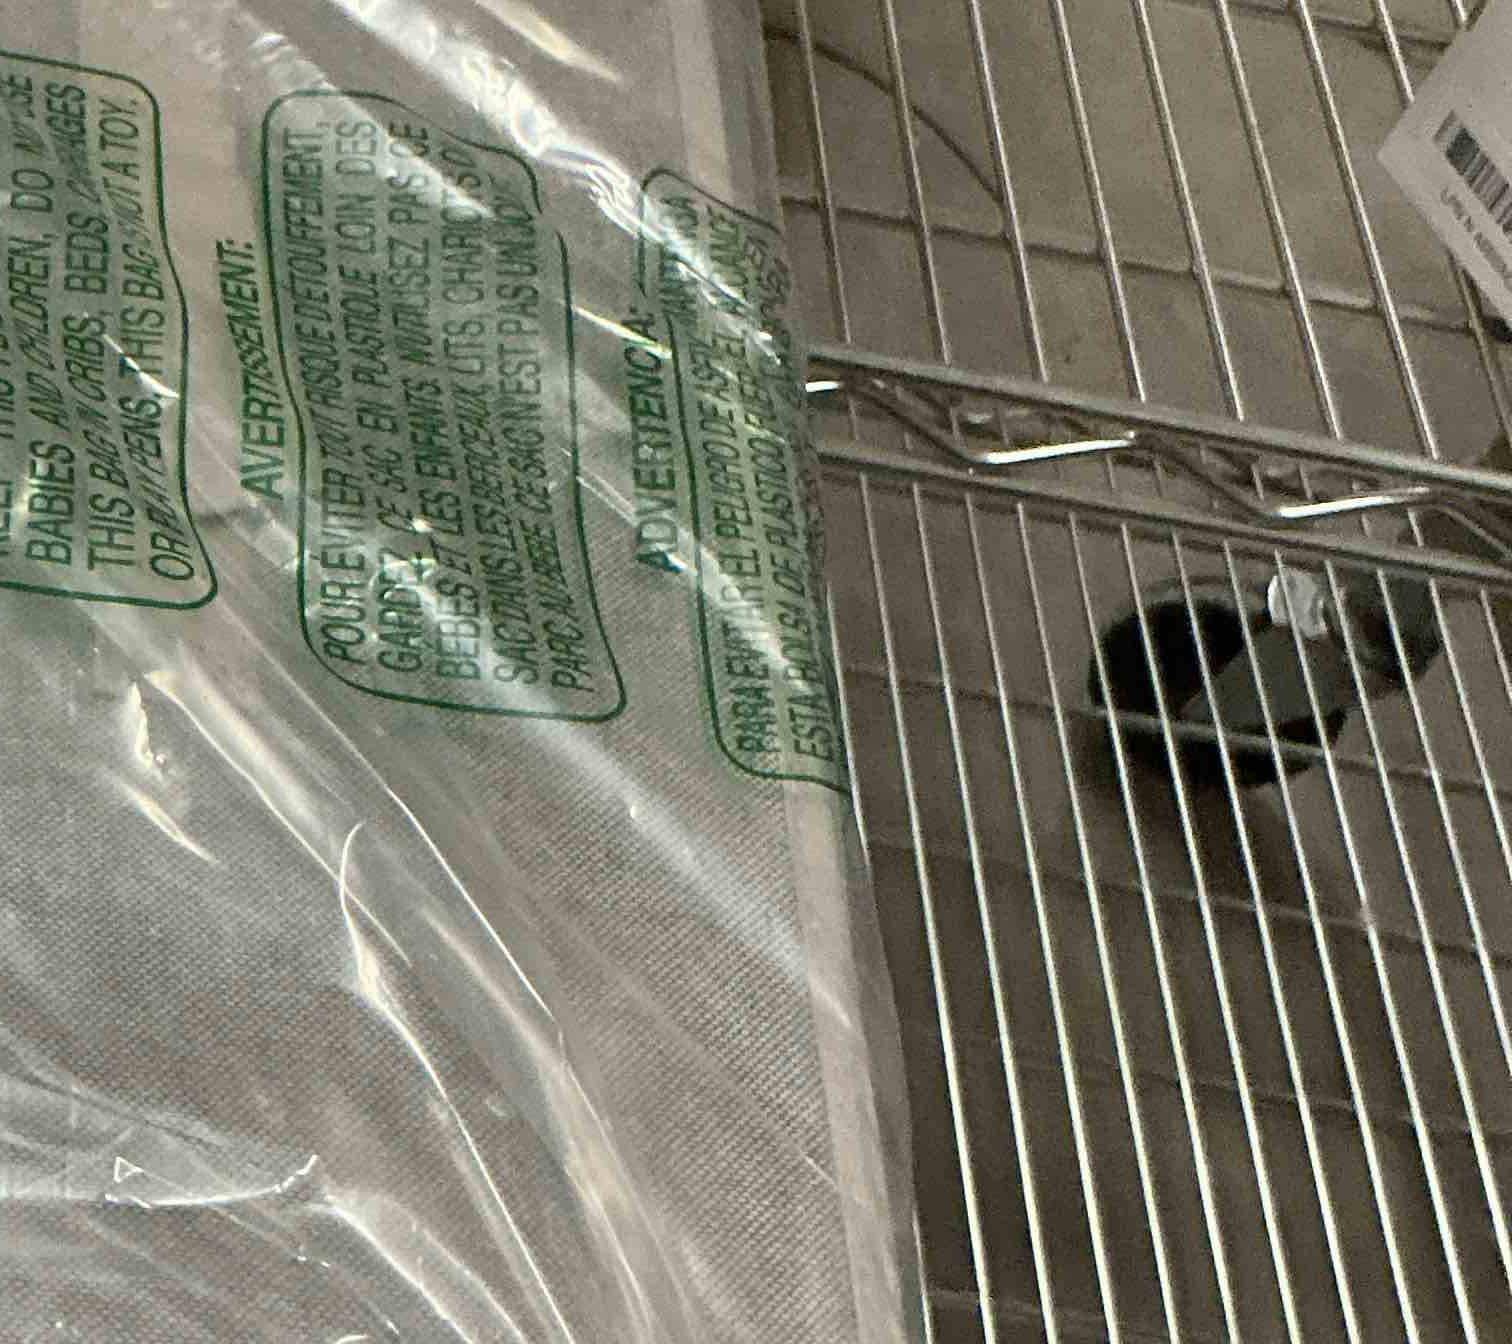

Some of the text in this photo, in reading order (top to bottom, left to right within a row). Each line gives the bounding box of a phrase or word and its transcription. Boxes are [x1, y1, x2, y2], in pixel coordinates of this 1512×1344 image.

[99, 98, 139, 152] TOY.
[336, 120, 377, 178] DES
[9, 168, 55, 214] DO
[101, 161, 139, 179] A
[387, 174, 430, 227] PAS
[334, 193, 377, 255] LOIN
[121, 242, 165, 302] BAG
[492, 240, 538, 277] UN
[337, 264, 389, 389] PLASTIQUE
[494, 283, 542, 337] PAS
[117, 305, 164, 379] THIS
[215, 238, 285, 502] AVERTISSEMENT:
[294, 321, 342, 407] RISQUE
[26, 371, 70, 432] AND
[356, 395, 398, 435] EN
[83, 430, 131, 489] BAG
[362, 445, 409, 494] SAC
[701, 439, 759, 540] PELIGRO
[24, 440, 77, 566] BABIES
[86, 493, 136, 571] THIS
[419, 493, 464, 538] LES
[149, 531, 195, 581] OR
[717, 548, 763, 578] EL
[481, 554, 531, 626] DANS
[320, 578, 368, 665] POUR
[491, 620, 540, 686] SAC
[541, 620, 594, 693] PARC
[728, 686, 782, 754] PARA
[786, 692, 835, 763] ESTA
